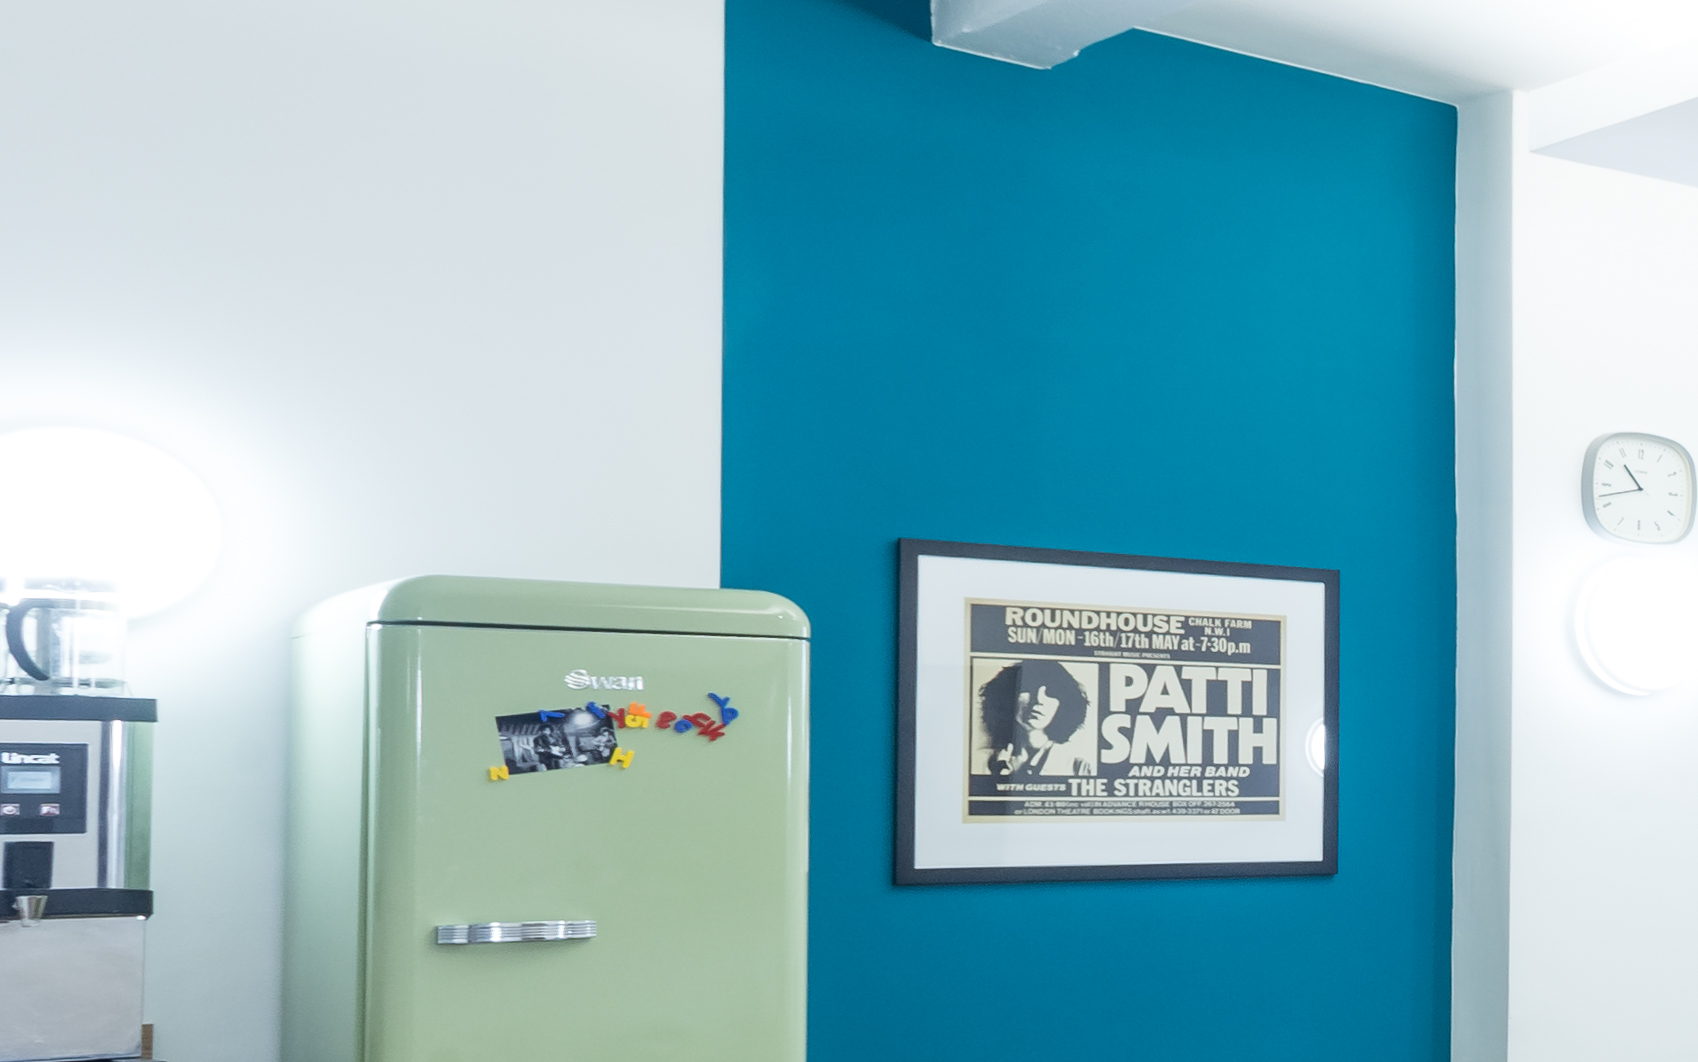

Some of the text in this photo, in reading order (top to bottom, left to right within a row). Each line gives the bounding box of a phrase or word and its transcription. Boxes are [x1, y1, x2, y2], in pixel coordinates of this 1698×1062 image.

[1005, 607, 1185, 634] ROUNDHOUSE
[1188, 617, 1252, 629] CHALK FARM
[1007, 627, 1076, 645] SUN/MON
[1152, 634, 1180, 650] MAY
[1181, 637, 1195, 651] at
[564, 669, 644, 690] Swan
[1110, 663, 1267, 715] PATTI
[1101, 714, 1277, 764] SMITH
[1, 752, 60, 764] Lincat
[1128, 765, 1251, 777] AND HER BAND
[996, 778, 1240, 797] WITH GUESTS THE STRANGLERS
